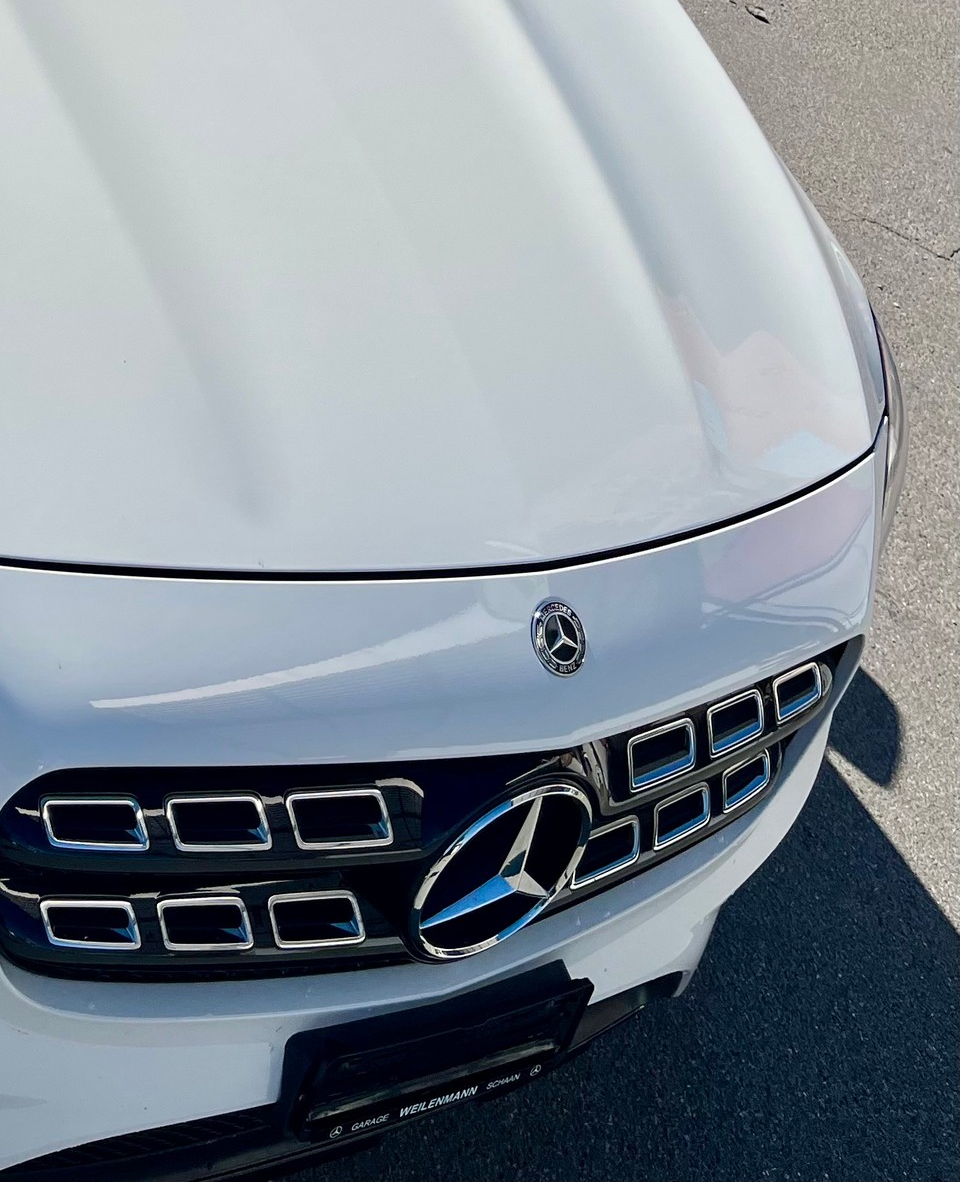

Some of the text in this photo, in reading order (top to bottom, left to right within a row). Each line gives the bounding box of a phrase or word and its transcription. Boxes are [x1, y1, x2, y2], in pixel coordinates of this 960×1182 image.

[558, 661, 578, 674] BENZ
[351, 1073, 521, 1131] GARAGE WEILENMANN SCHAAN
